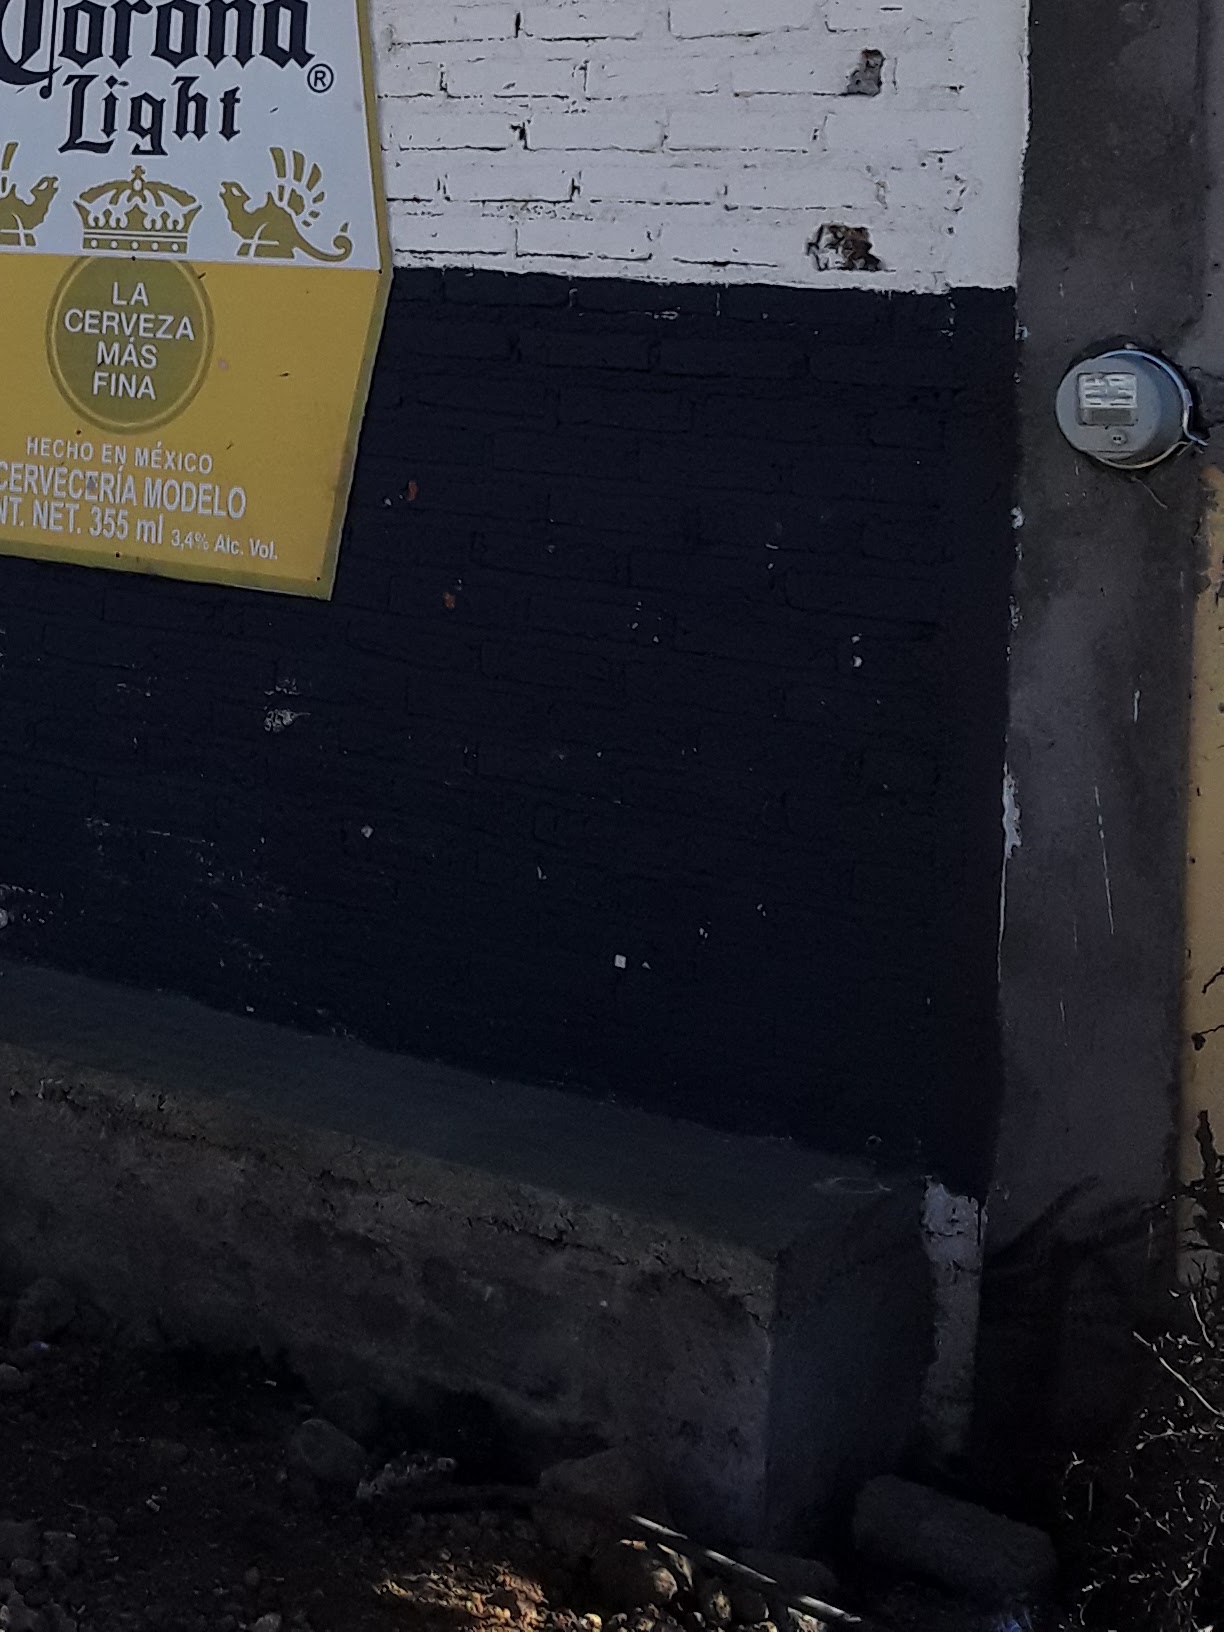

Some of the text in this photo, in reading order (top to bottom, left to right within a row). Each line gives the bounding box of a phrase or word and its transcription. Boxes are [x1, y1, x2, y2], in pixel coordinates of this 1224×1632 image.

[58, 74, 241, 156] Light
[112, 281, 150, 306] LA
[64, 309, 195, 342] CERVEZA
[96, 337, 157, 369] MÁS
[92, 372, 156, 401] FINA
[26, 436, 213, 475] HECHO EN MÉXICO
[143, 476, 247, 520] MODELO
[32, 499, 82, 535] NET.
[89, 506, 129, 540] 355
[136, 513, 163, 544] ml
[214, 533, 244, 556] Alc.
[249, 537, 278, 561] Vol.
